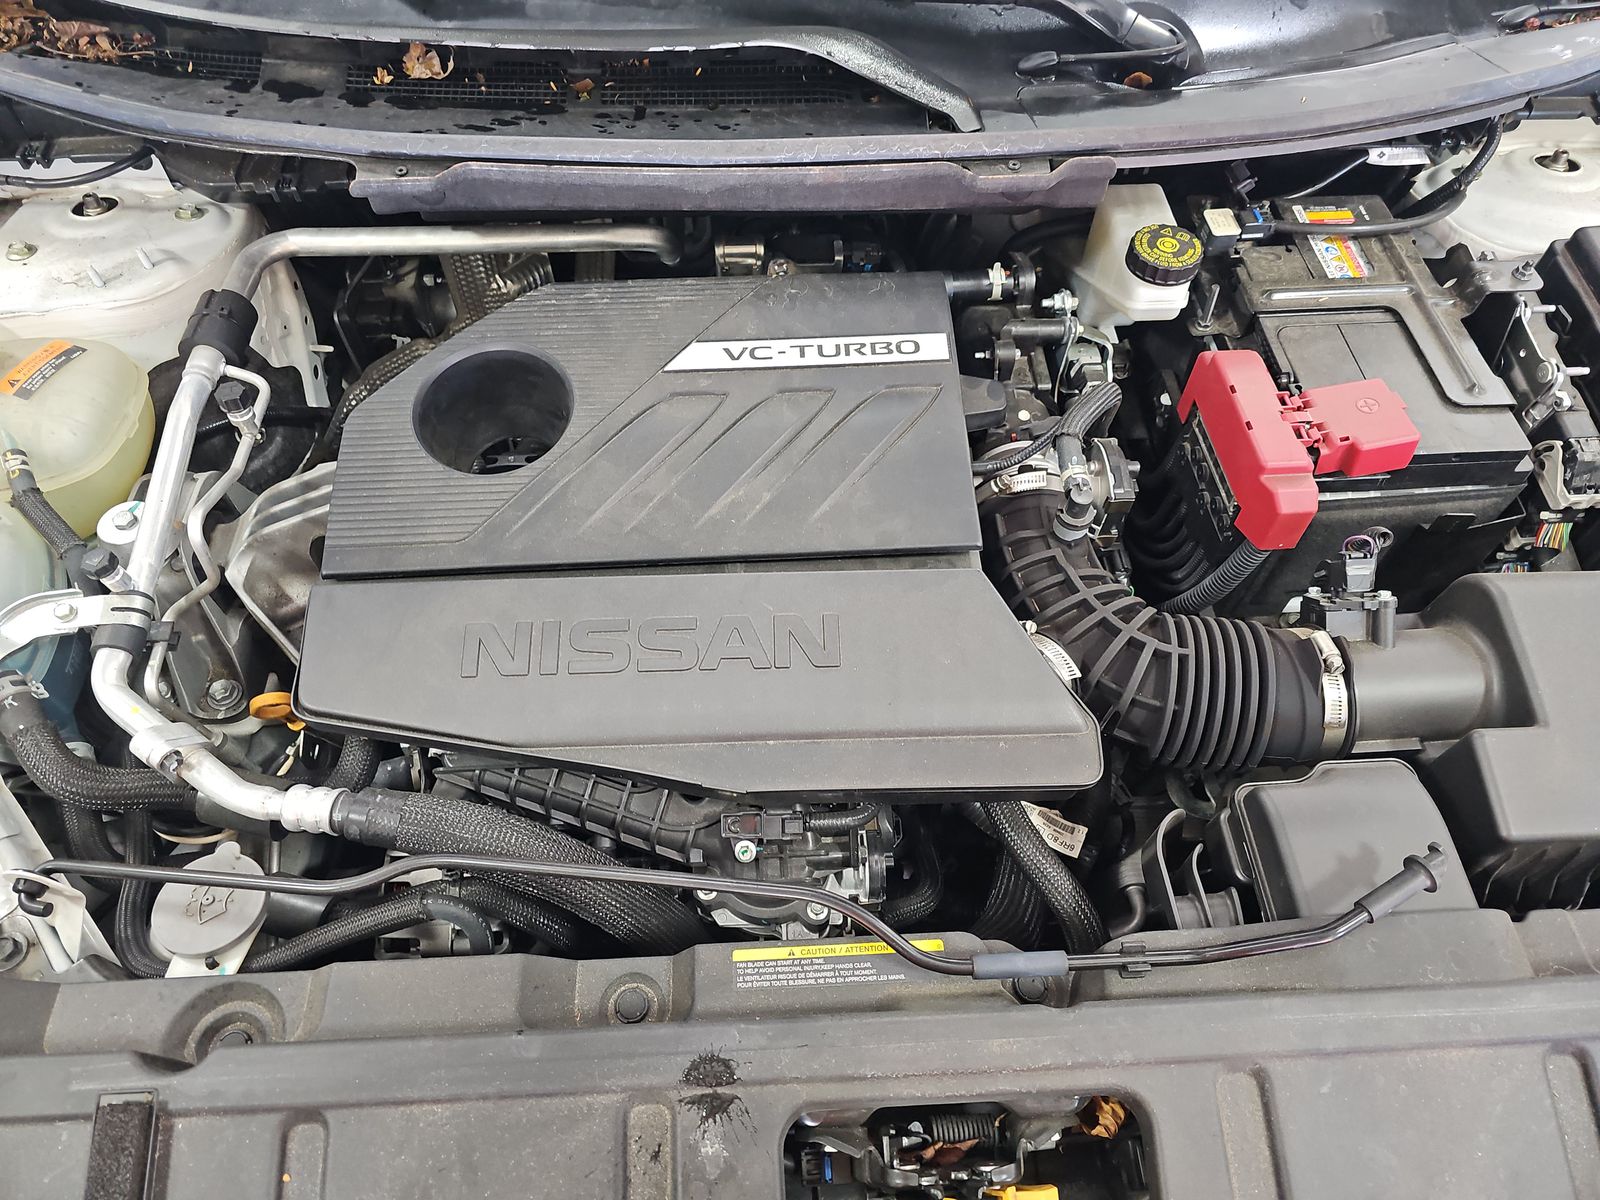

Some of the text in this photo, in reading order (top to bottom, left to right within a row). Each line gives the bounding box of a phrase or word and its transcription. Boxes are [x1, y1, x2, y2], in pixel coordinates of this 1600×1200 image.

[722, 340, 920, 360] VC-TURBO
[460, 613, 842, 678] NISSAN
[1046, 833, 1076, 852] 6RF8D
[800, 947, 836, 956] CAUTION
[845, 945, 888, 953] ATTENTION
